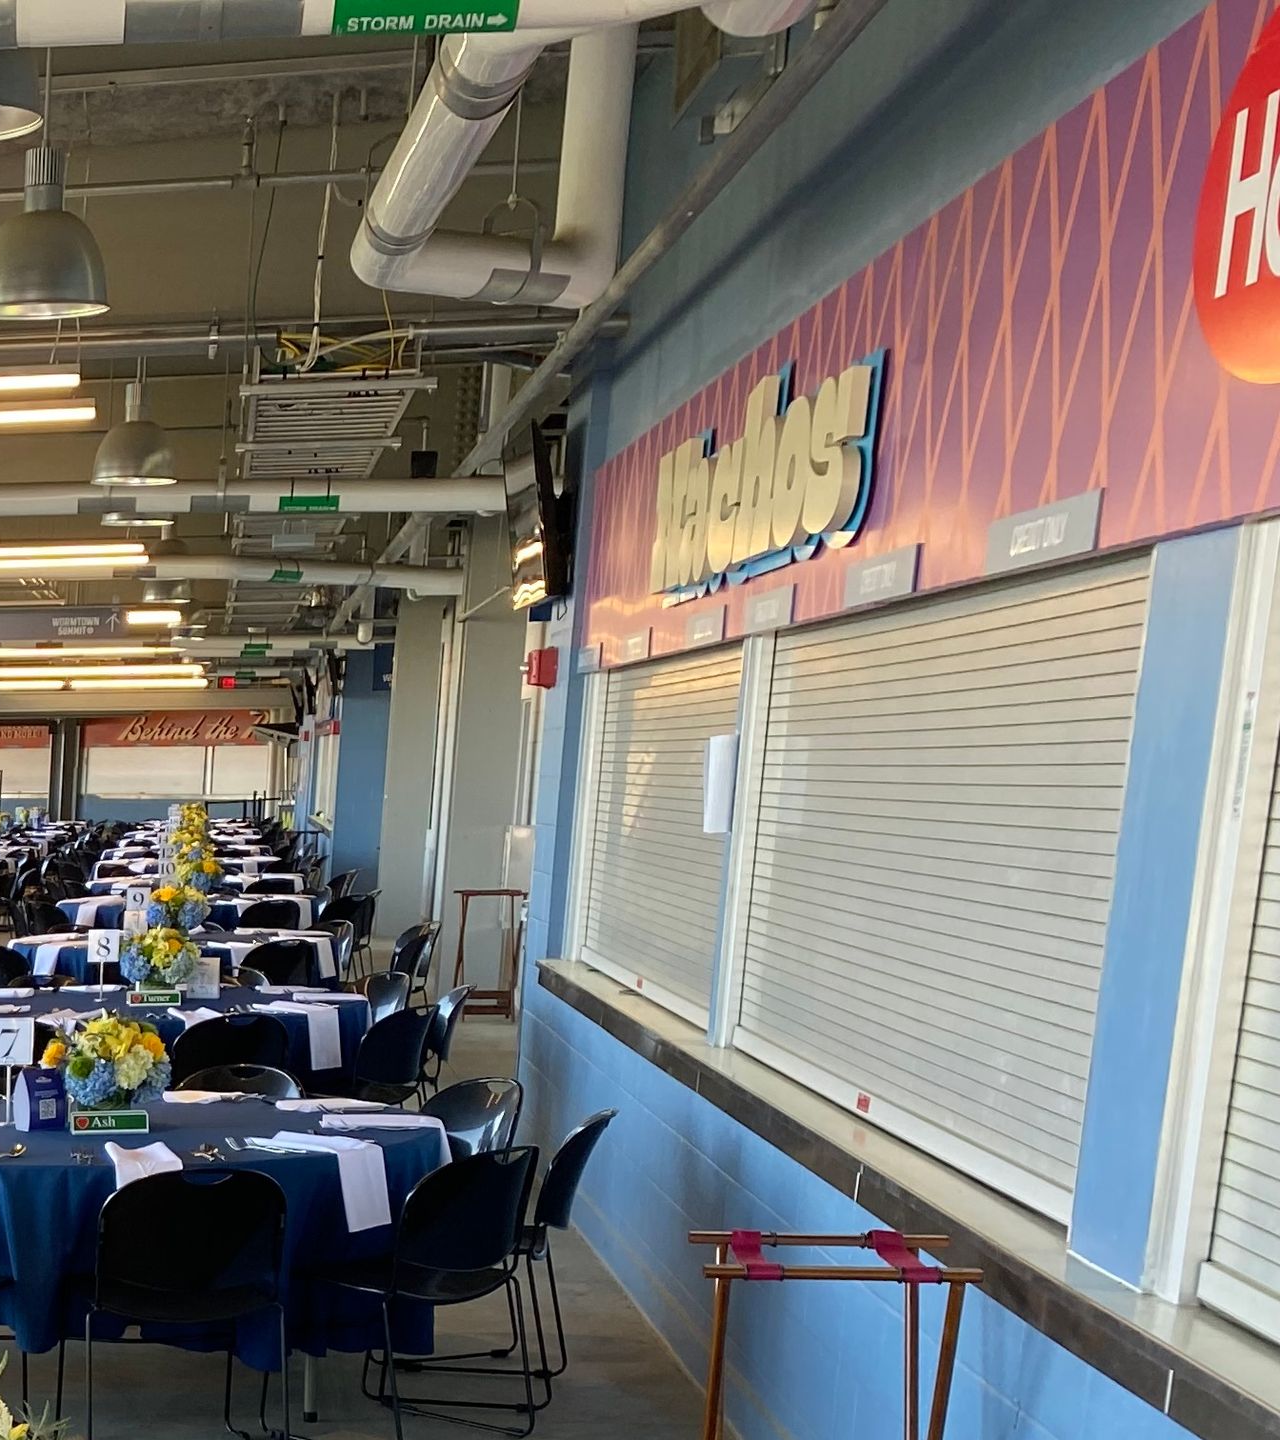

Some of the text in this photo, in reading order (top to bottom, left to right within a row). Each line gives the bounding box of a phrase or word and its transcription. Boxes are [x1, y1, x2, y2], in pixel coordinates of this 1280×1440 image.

[347, 13, 485, 32] STORM DRAIN
[650, 365, 873, 595] Nachos
[117, 714, 199, 741] Behind
[204, 714, 240, 740] the
[160, 863, 175, 875] 10
[133, 892, 144, 905] 9
[96, 936, 110, 957] 8
[0, 1028, 21, 1058] 7
[91, 1115, 116, 1128] Ash
